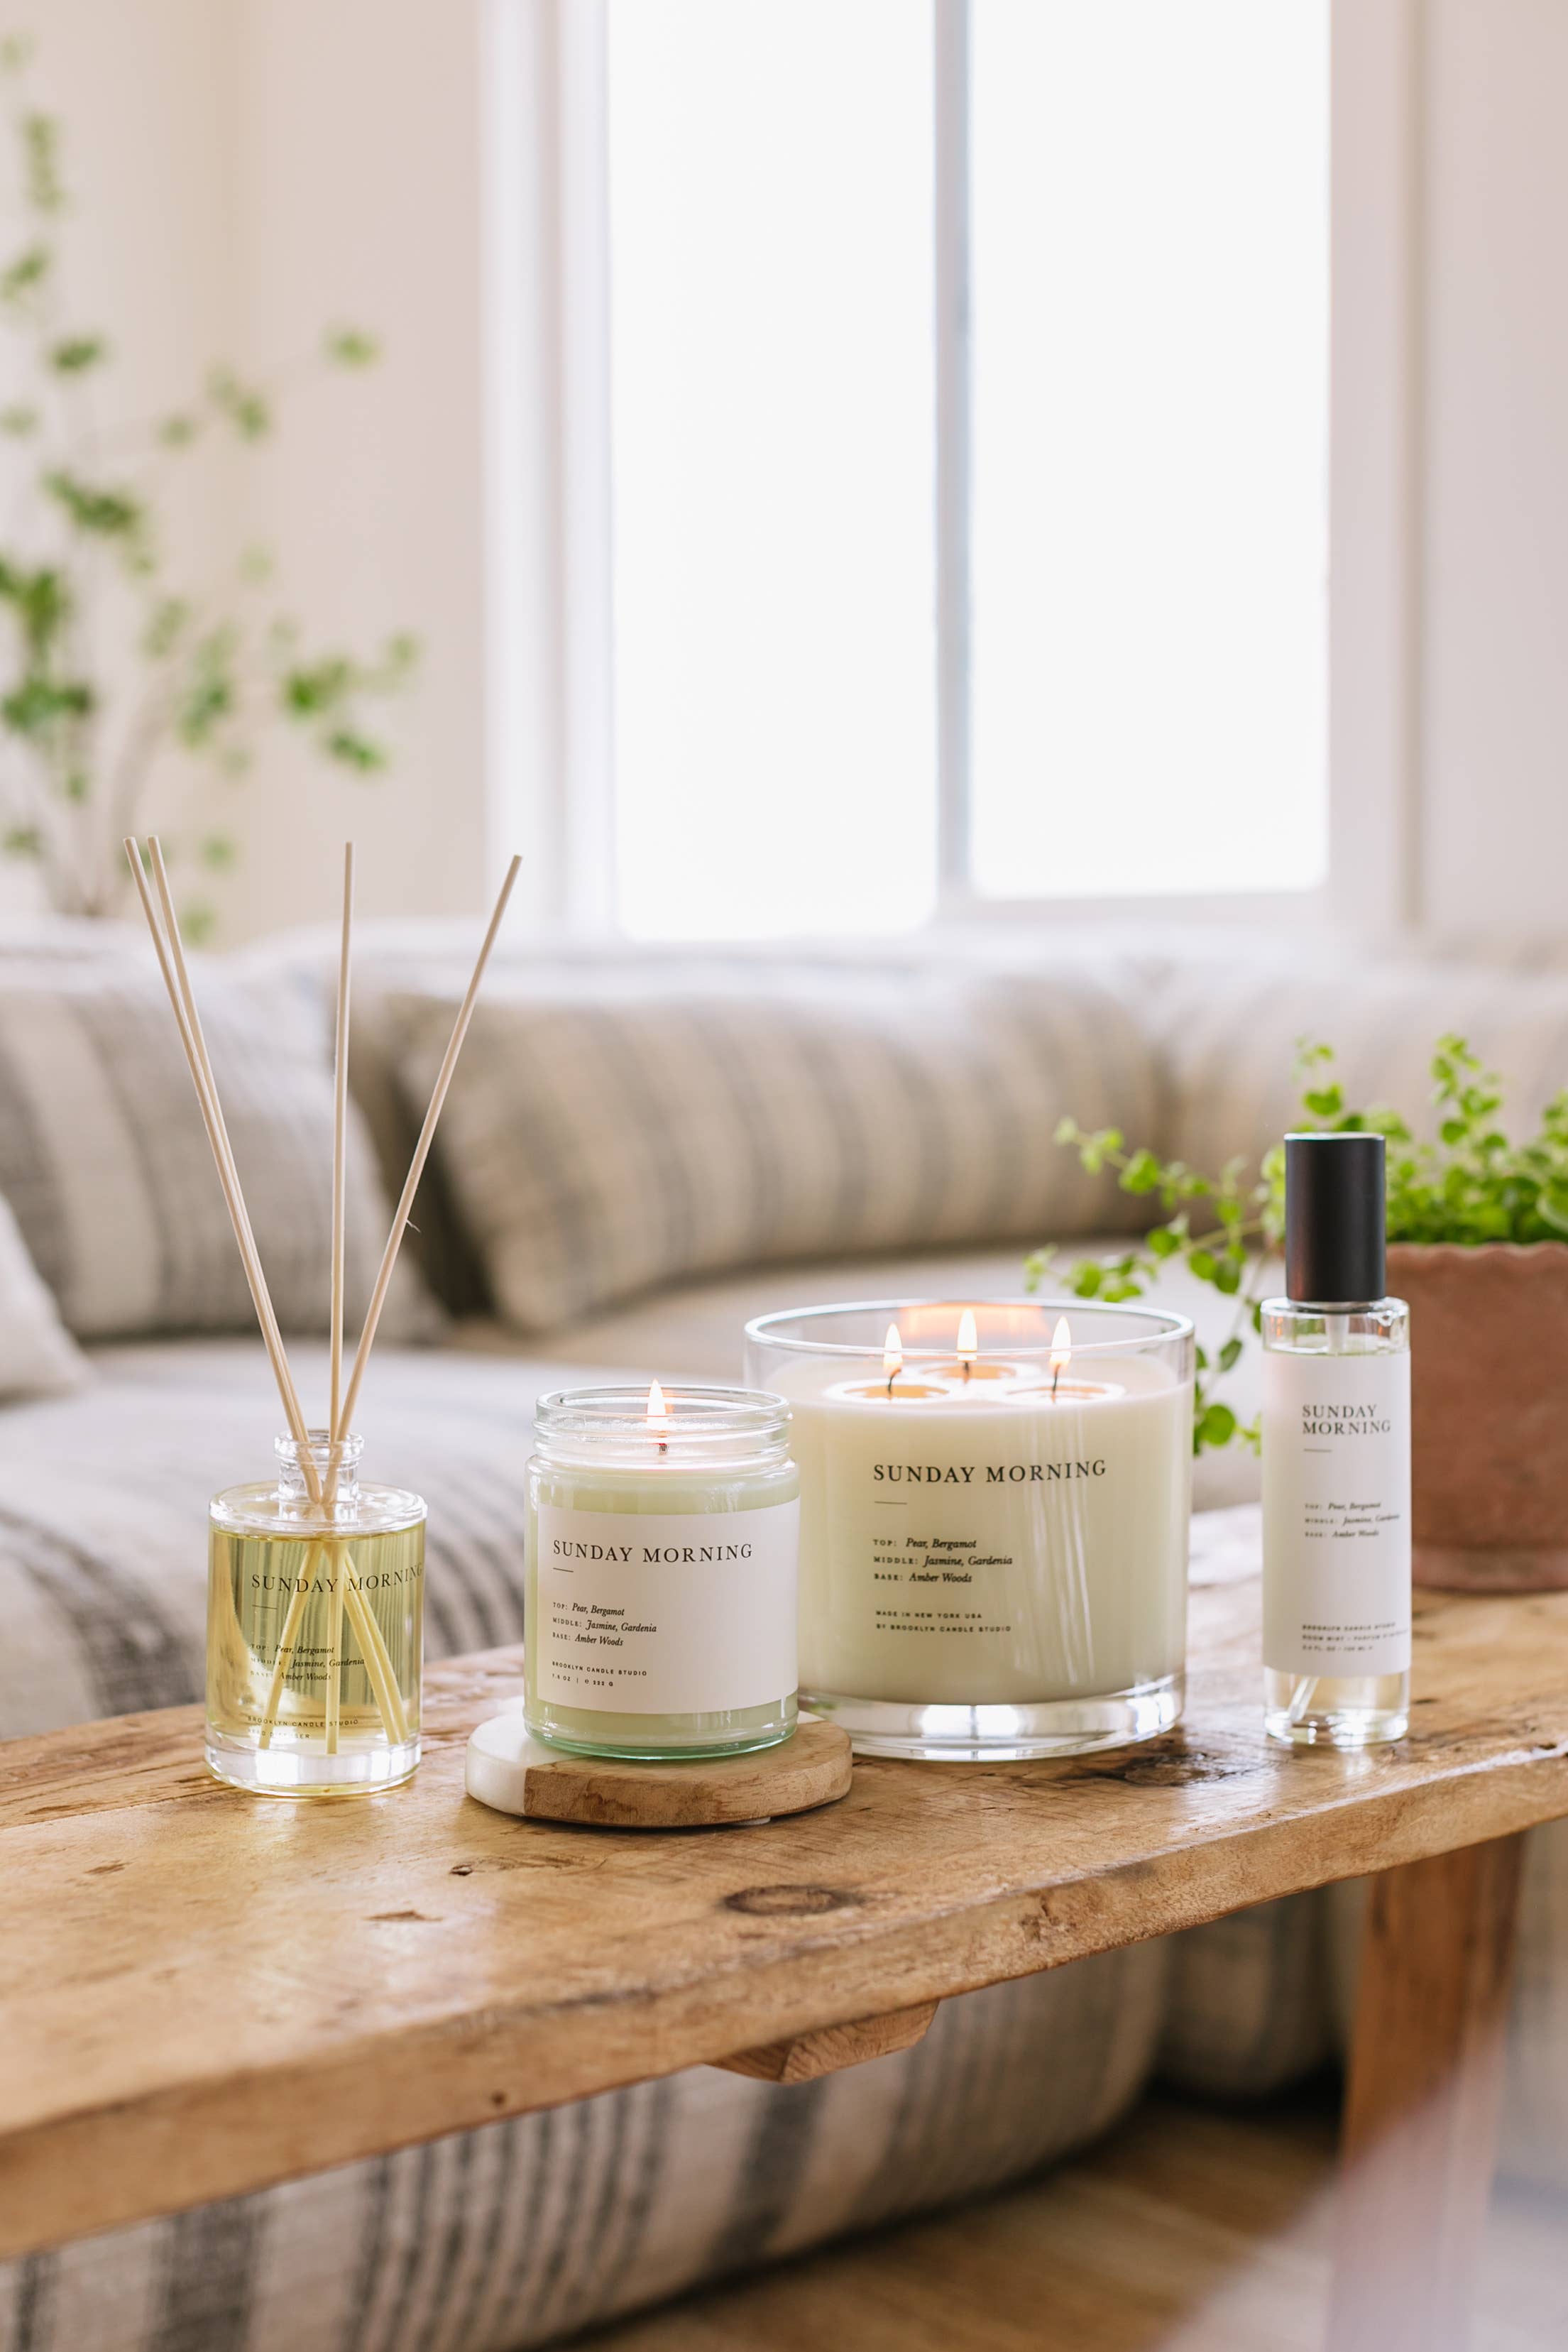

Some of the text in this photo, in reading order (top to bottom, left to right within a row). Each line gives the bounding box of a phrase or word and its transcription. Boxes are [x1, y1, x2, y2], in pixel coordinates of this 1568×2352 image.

[1302, 1404, 1376, 1418] SUNDAY
[1303, 1420, 1391, 1435] MORNING
[874, 1460, 1106, 1483] SUNDAY MORNING
[553, 1539, 752, 1563] SUNDAY MORNING
[906, 1538, 928, 1549] Pear,
[932, 1538, 977, 1551] Bergamot
[873, 1555, 1013, 1568] MIDDLE: Jasmine, Gardenia
[251, 1562, 423, 1593] SUNDAY MORNING
[909, 1572, 939, 1582] Amber
[942, 1572, 972, 1583] Woods
[553, 1602, 625, 1617] TOP: Pear, Bergamot
[552, 1617, 657, 1633] MIDDLE: Jasmine, Gardenia
[552, 1631, 624, 1646] BASE: Amber Woods
[275, 1644, 294, 1654] Pear,
[297, 1646, 334, 1656] Bergamot
[291, 1659, 326, 1668] Jasmine,
[329, 1658, 365, 1668] Gardenia
[552, 1661, 583, 1670] BROOKLYN
[586, 1666, 614, 1675] CANDLE
[280, 1672, 304, 1681] Amber
[307, 1673, 331, 1681] Woods
[248, 1716, 288, 1727] BROOKLYN
